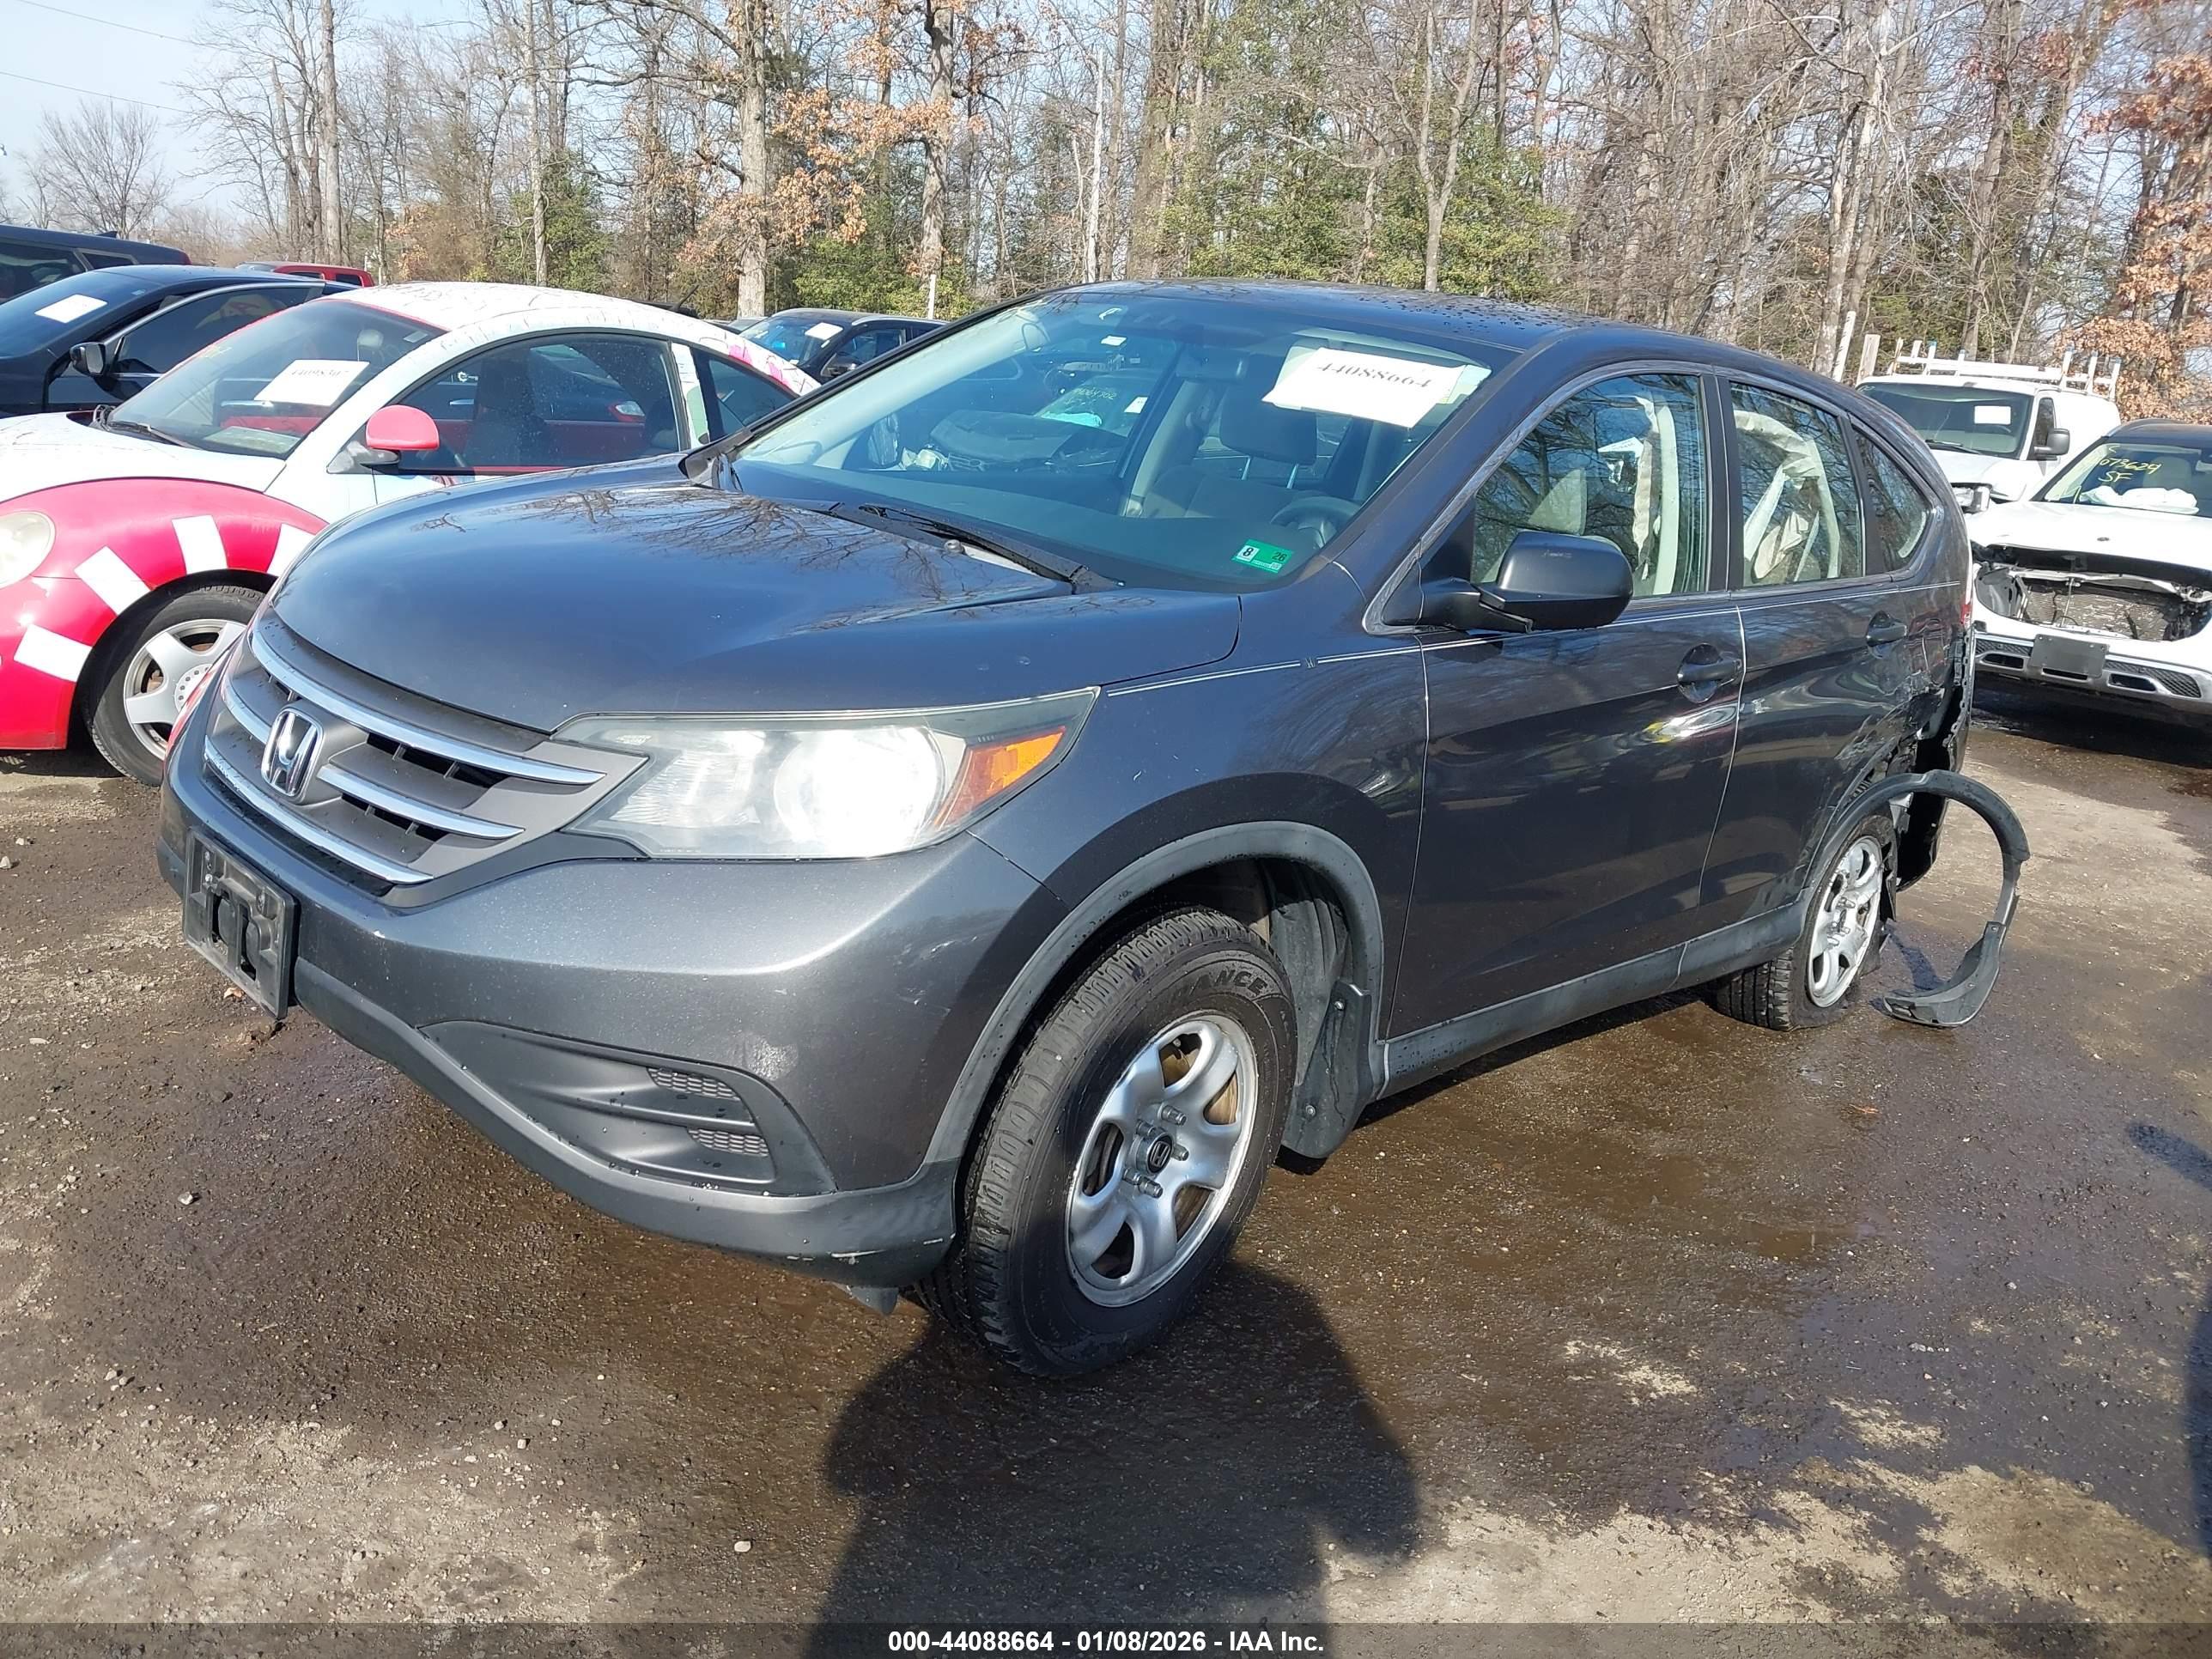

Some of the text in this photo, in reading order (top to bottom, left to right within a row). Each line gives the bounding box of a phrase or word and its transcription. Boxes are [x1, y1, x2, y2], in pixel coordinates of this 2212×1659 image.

[1317, 362, 1431, 387] 44088664
[2098, 471, 2134, 483] SF
[1243, 547, 1287, 562] 8 26
